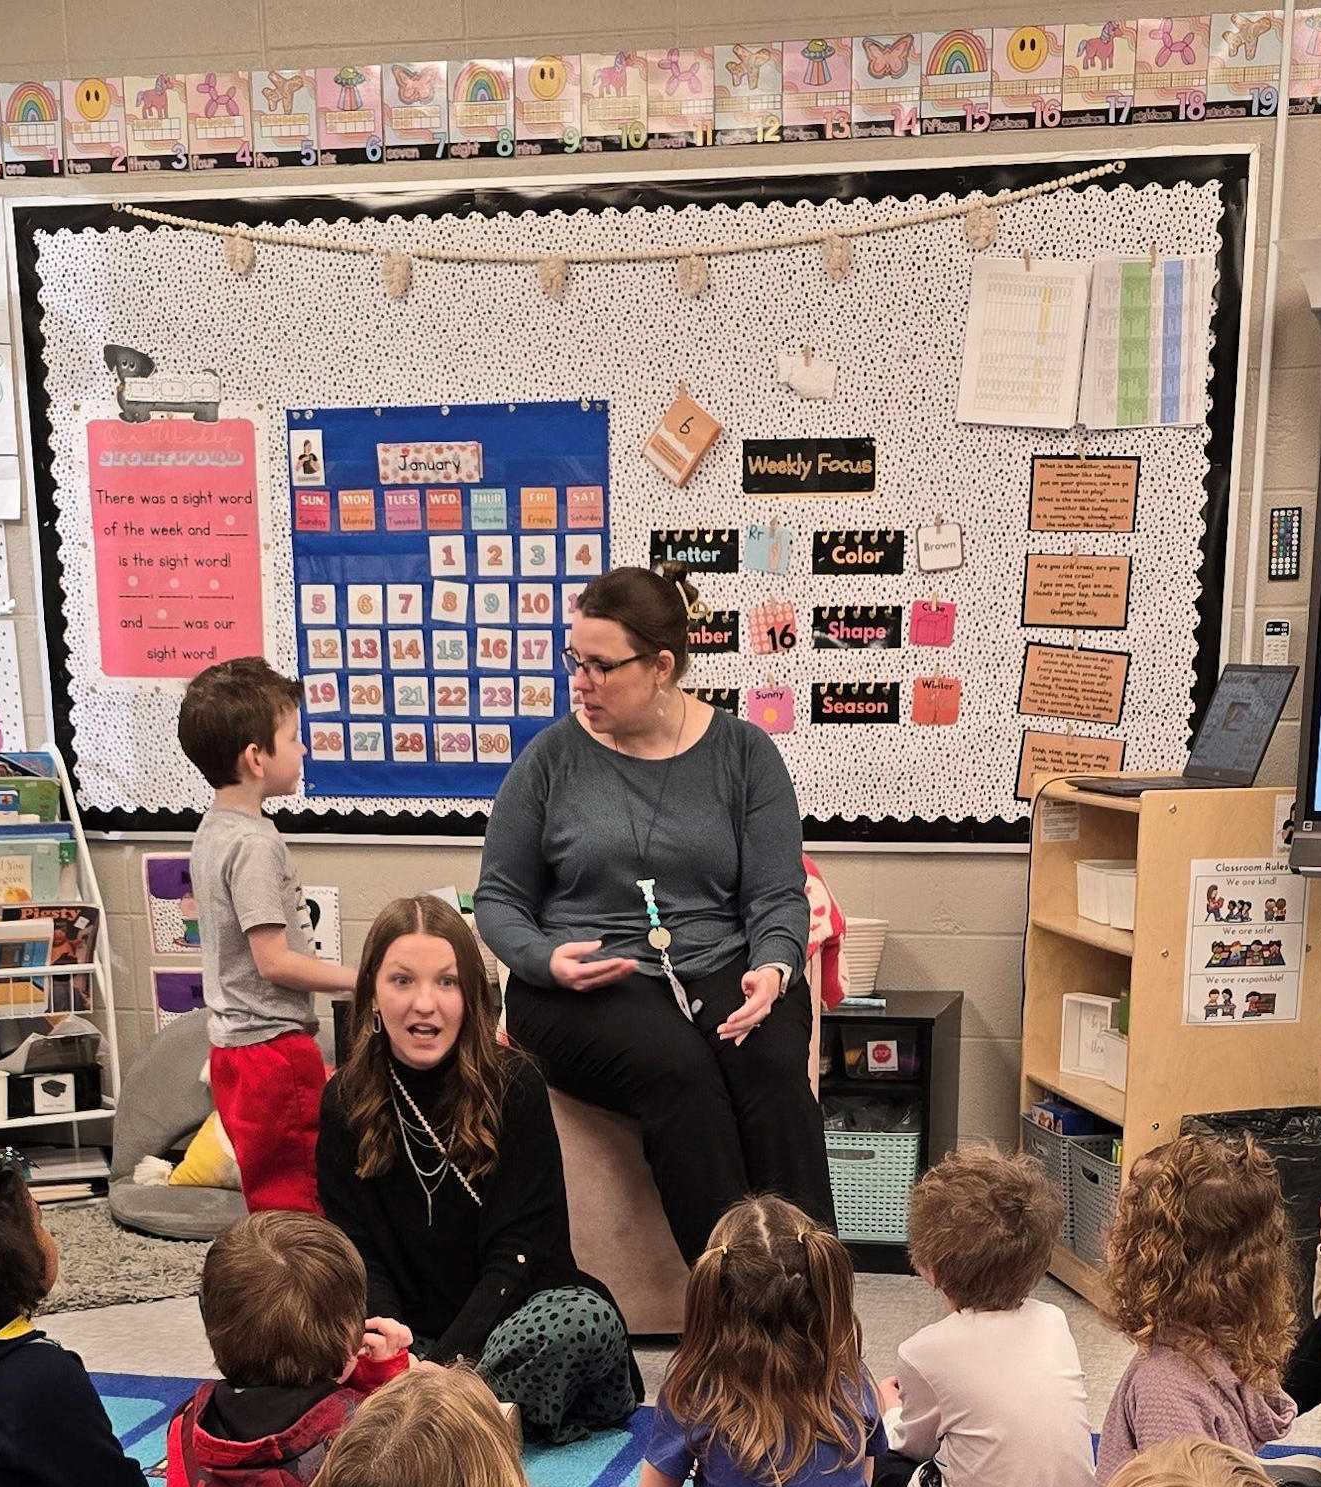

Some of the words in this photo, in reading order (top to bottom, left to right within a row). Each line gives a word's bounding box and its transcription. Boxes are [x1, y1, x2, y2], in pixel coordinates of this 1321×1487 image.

[1032, 99, 1061, 128] 16
[1107, 95, 1132, 124] 17
[1176, 90, 1206, 121] 18
[1250, 86, 1278, 116] 19
[755, 115, 782, 143] 12
[824, 110, 851, 139] 13
[891, 103, 921, 136] 14
[963, 102, 990, 132] 15
[433, 132, 446, 158] 7
[496, 127, 513, 157] 8
[562, 126, 579, 153] 9
[618, 120, 647, 149] 10
[694, 119, 713, 147] 11
[49, 148, 59, 173] 1
[110, 146, 126, 171] 2
[171, 143, 188, 170] 3
[236, 141, 252, 166] 4
[300, 139, 316, 166] 5
[365, 135, 381, 162] 6
[398, 455, 461, 472] January
[747, 452, 812, 481] Weekly
[817, 453, 873, 475] Focus
[95, 490, 135, 505] There
[140, 493, 165, 505] was
[170, 494, 178, 505] a
[183, 490, 214, 509] sight
[219, 490, 252, 505] word
[104, 522, 118, 537] of
[124, 522, 145, 536] the
[150, 522, 183, 536] week
[188, 522, 211, 536] and
[666, 544, 721, 564] Letter
[831, 545, 884, 565] Color
[924, 540, 956, 551] Brown
[118, 554, 128, 568] is
[133, 553, 154, 568] the
[159, 553, 189, 572] sight
[193, 553, 231, 568] word!
[120, 615, 143, 629] and
[184, 618, 209, 629] was
[214, 619, 236, 629] our
[828, 621, 887, 644] Shape
[766, 624, 797, 651] 16
[146, 647, 177, 665] sight
[182, 647, 217, 660] word!
[755, 690, 784, 700] Sunny
[822, 698, 888, 715] Season
[1215, 863, 1262, 872] Classroom
[1265, 862, 1289, 871] Rules
[1226, 878, 1240, 886] We
[1258, 877, 1277, 885] kind!
[20, 907, 81, 921] Pigsty
